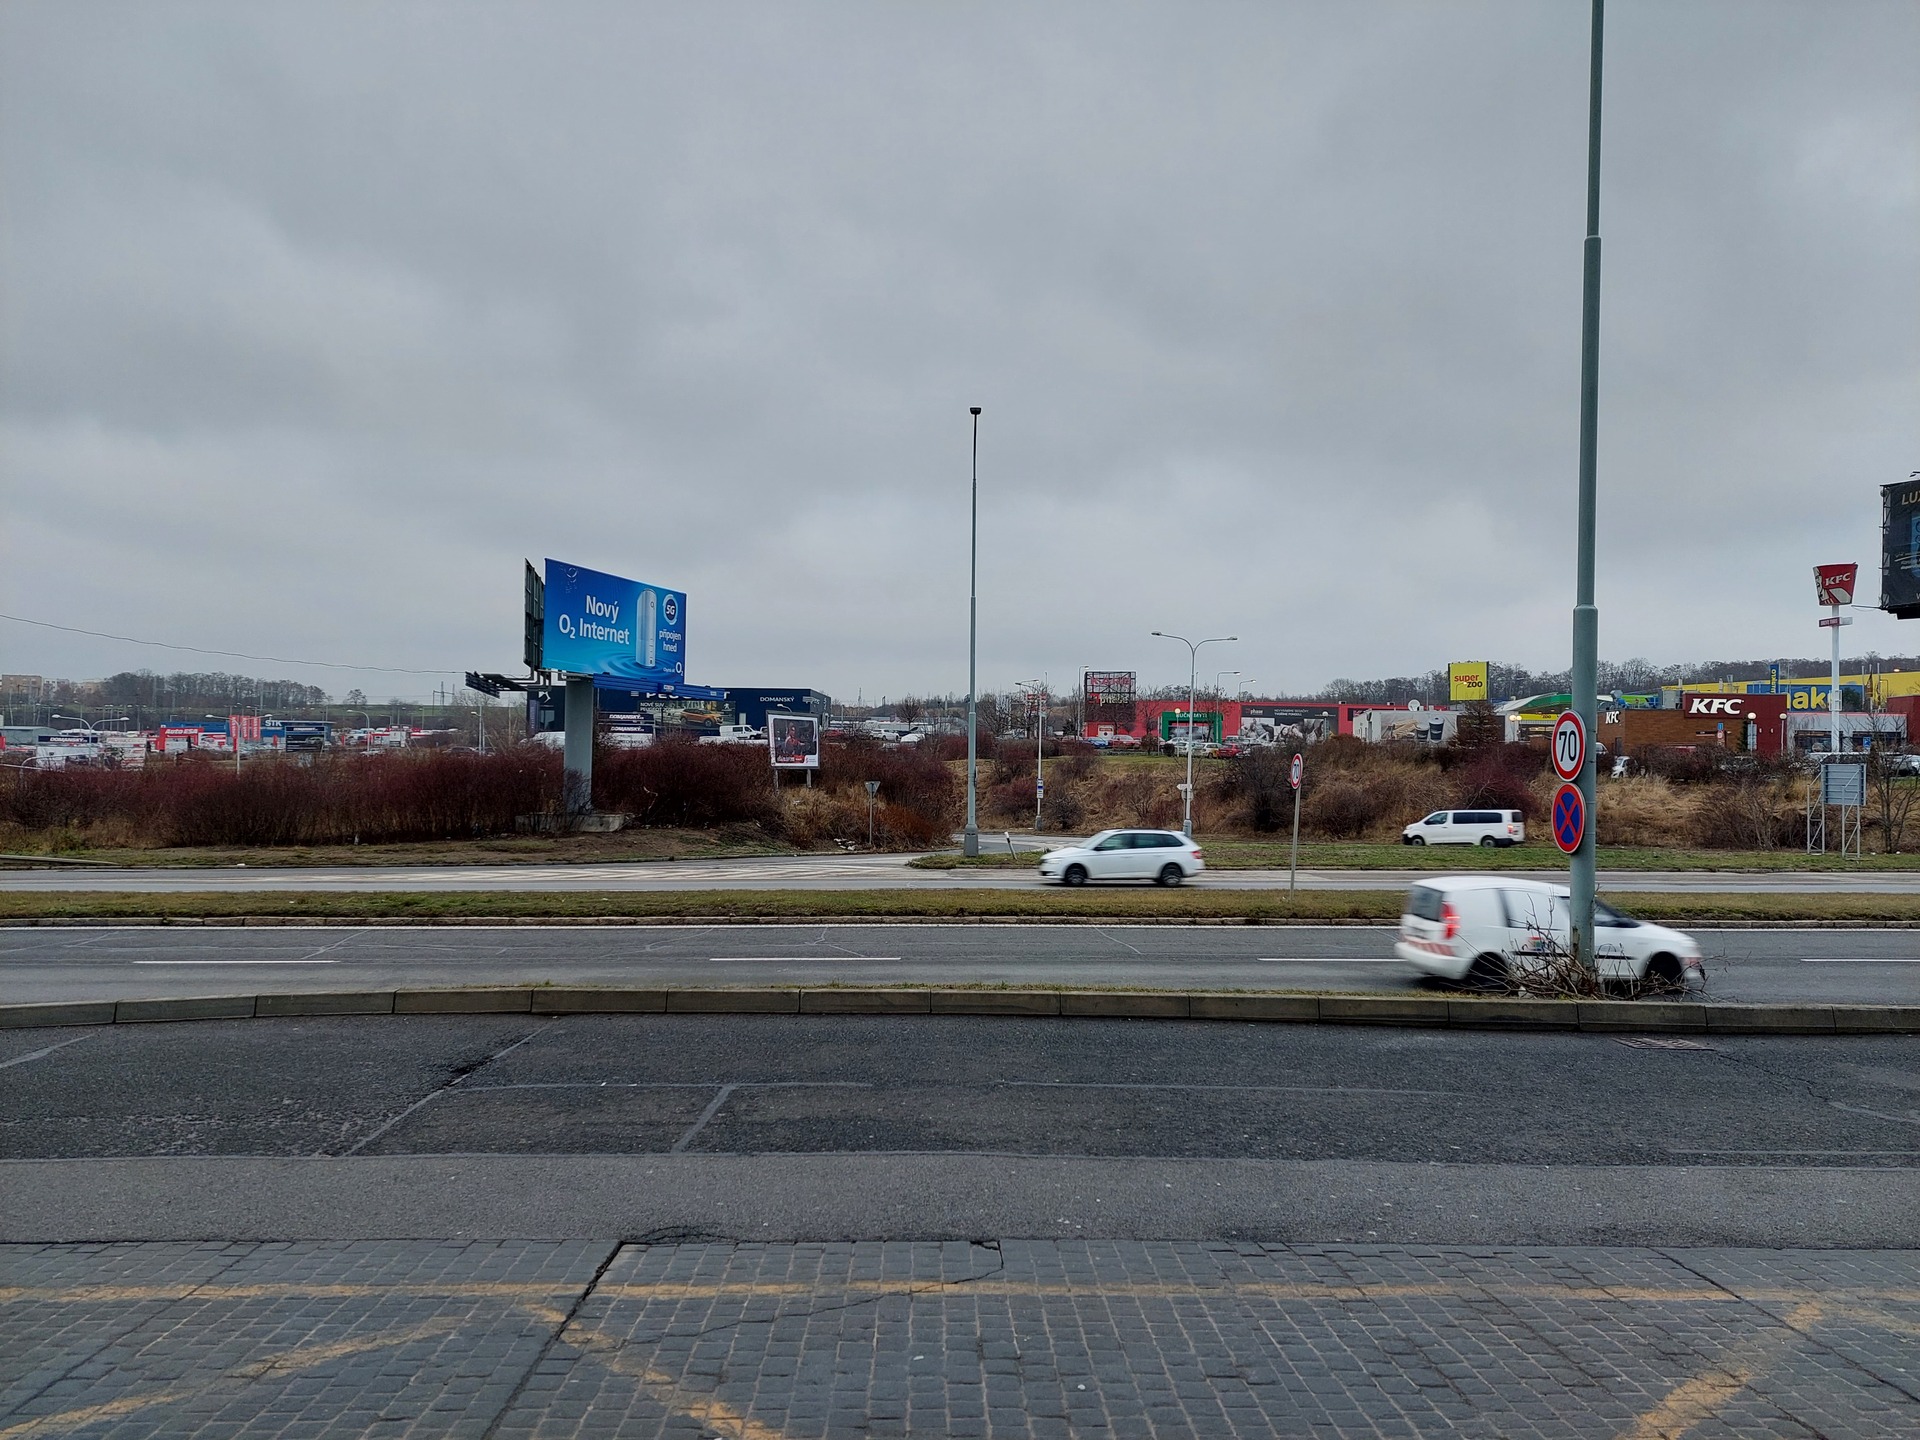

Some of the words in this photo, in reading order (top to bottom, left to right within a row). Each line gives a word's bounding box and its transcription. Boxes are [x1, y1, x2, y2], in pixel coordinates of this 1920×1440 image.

[1901, 490, 1920, 506] LU
[1825, 572, 1851, 586] KFC
[585, 594, 620, 624] Nový
[665, 604, 676, 615] 5G
[579, 617, 630, 645] Internet
[659, 628, 682, 642] připojen
[663, 640, 678, 653] hned
[1454, 674, 1479, 686] super
[1688, 698, 1742, 715] KFC
[265, 719, 282, 727] STK
[1605, 710, 1620, 724] KFC
[1558, 730, 1577, 762] 70
